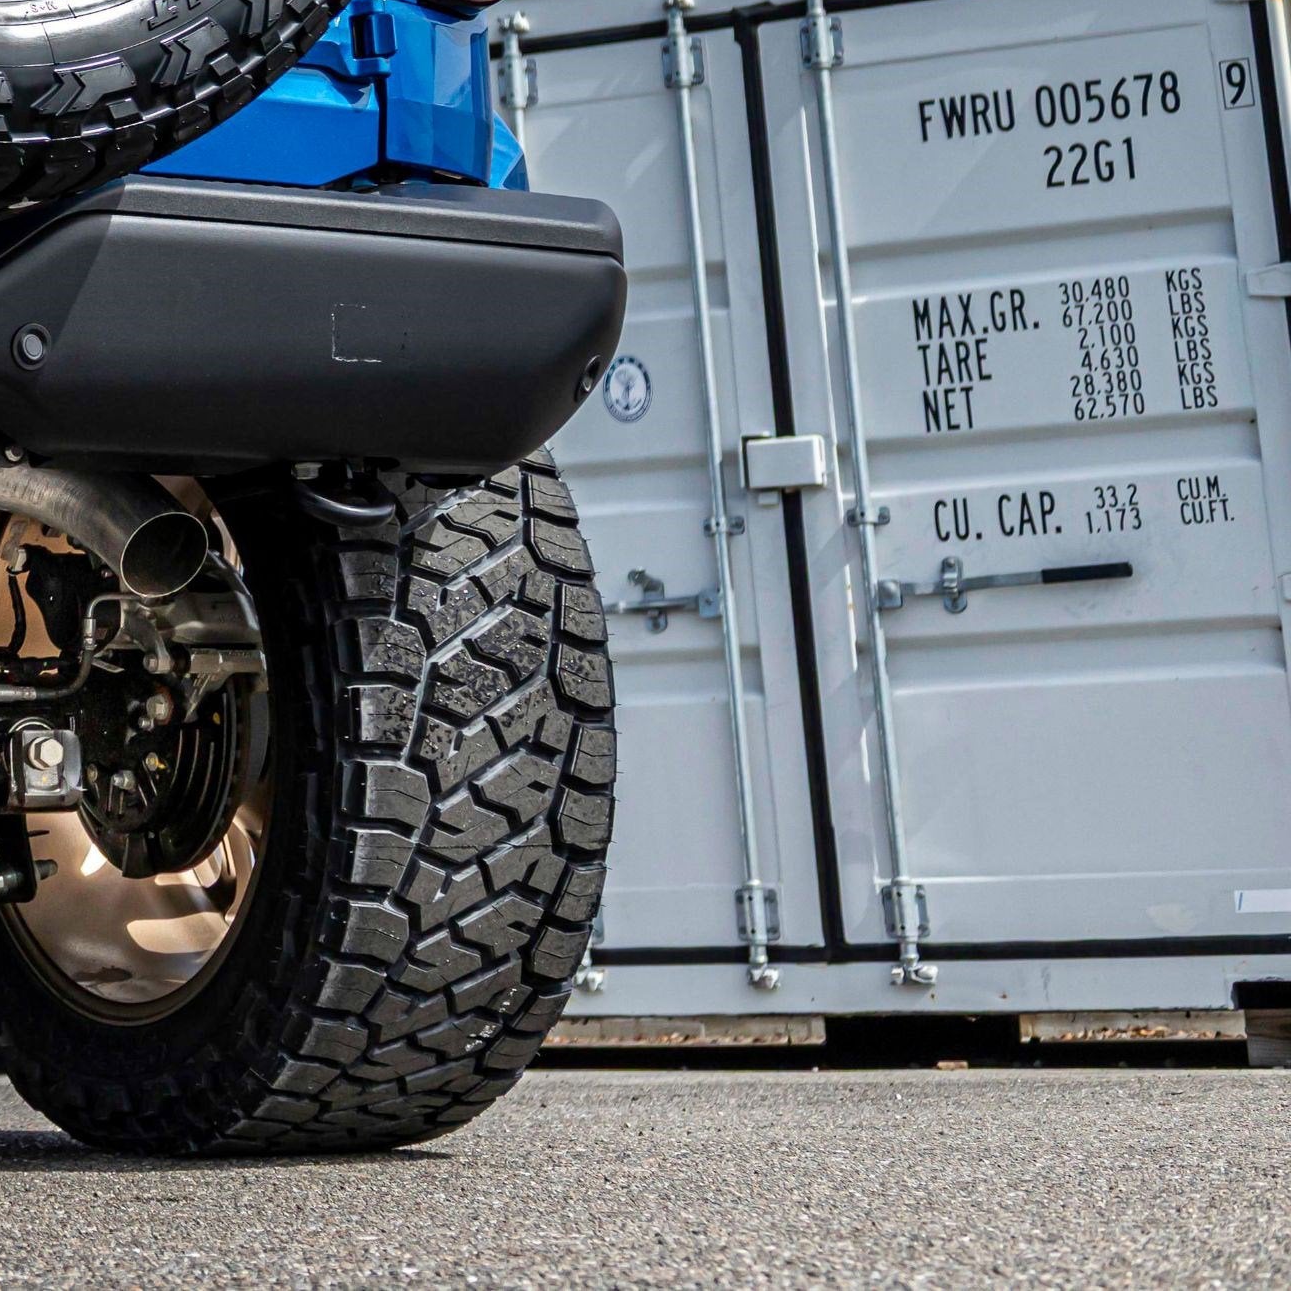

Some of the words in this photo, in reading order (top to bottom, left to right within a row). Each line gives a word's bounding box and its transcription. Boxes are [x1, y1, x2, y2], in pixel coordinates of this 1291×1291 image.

[918, 89, 1016, 143] FWRU
[1035, 70, 1182, 128] 005678
[1225, 61, 1248, 106] 9
[1044, 136, 1137, 189] 22G1
[913, 288, 1040, 342] MAX.GR.
[1165, 267, 1203, 293] KGS
[1169, 291, 1206, 316] LBS
[917, 339, 993, 387] TARE
[1172, 314, 1209, 339] KGS
[1174, 338, 1212, 363] LBS
[922, 388, 975, 433] NET
[1178, 362, 1215, 386] KGS
[1180, 385, 1218, 410] LBS
[933, 498, 983, 542] CU.
[997, 491, 1063, 536] CAP.
[1094, 483, 1139, 509] 33.2
[1176, 475, 1227, 501] CU.M.
[1180, 498, 1236, 525] CU.FT.
